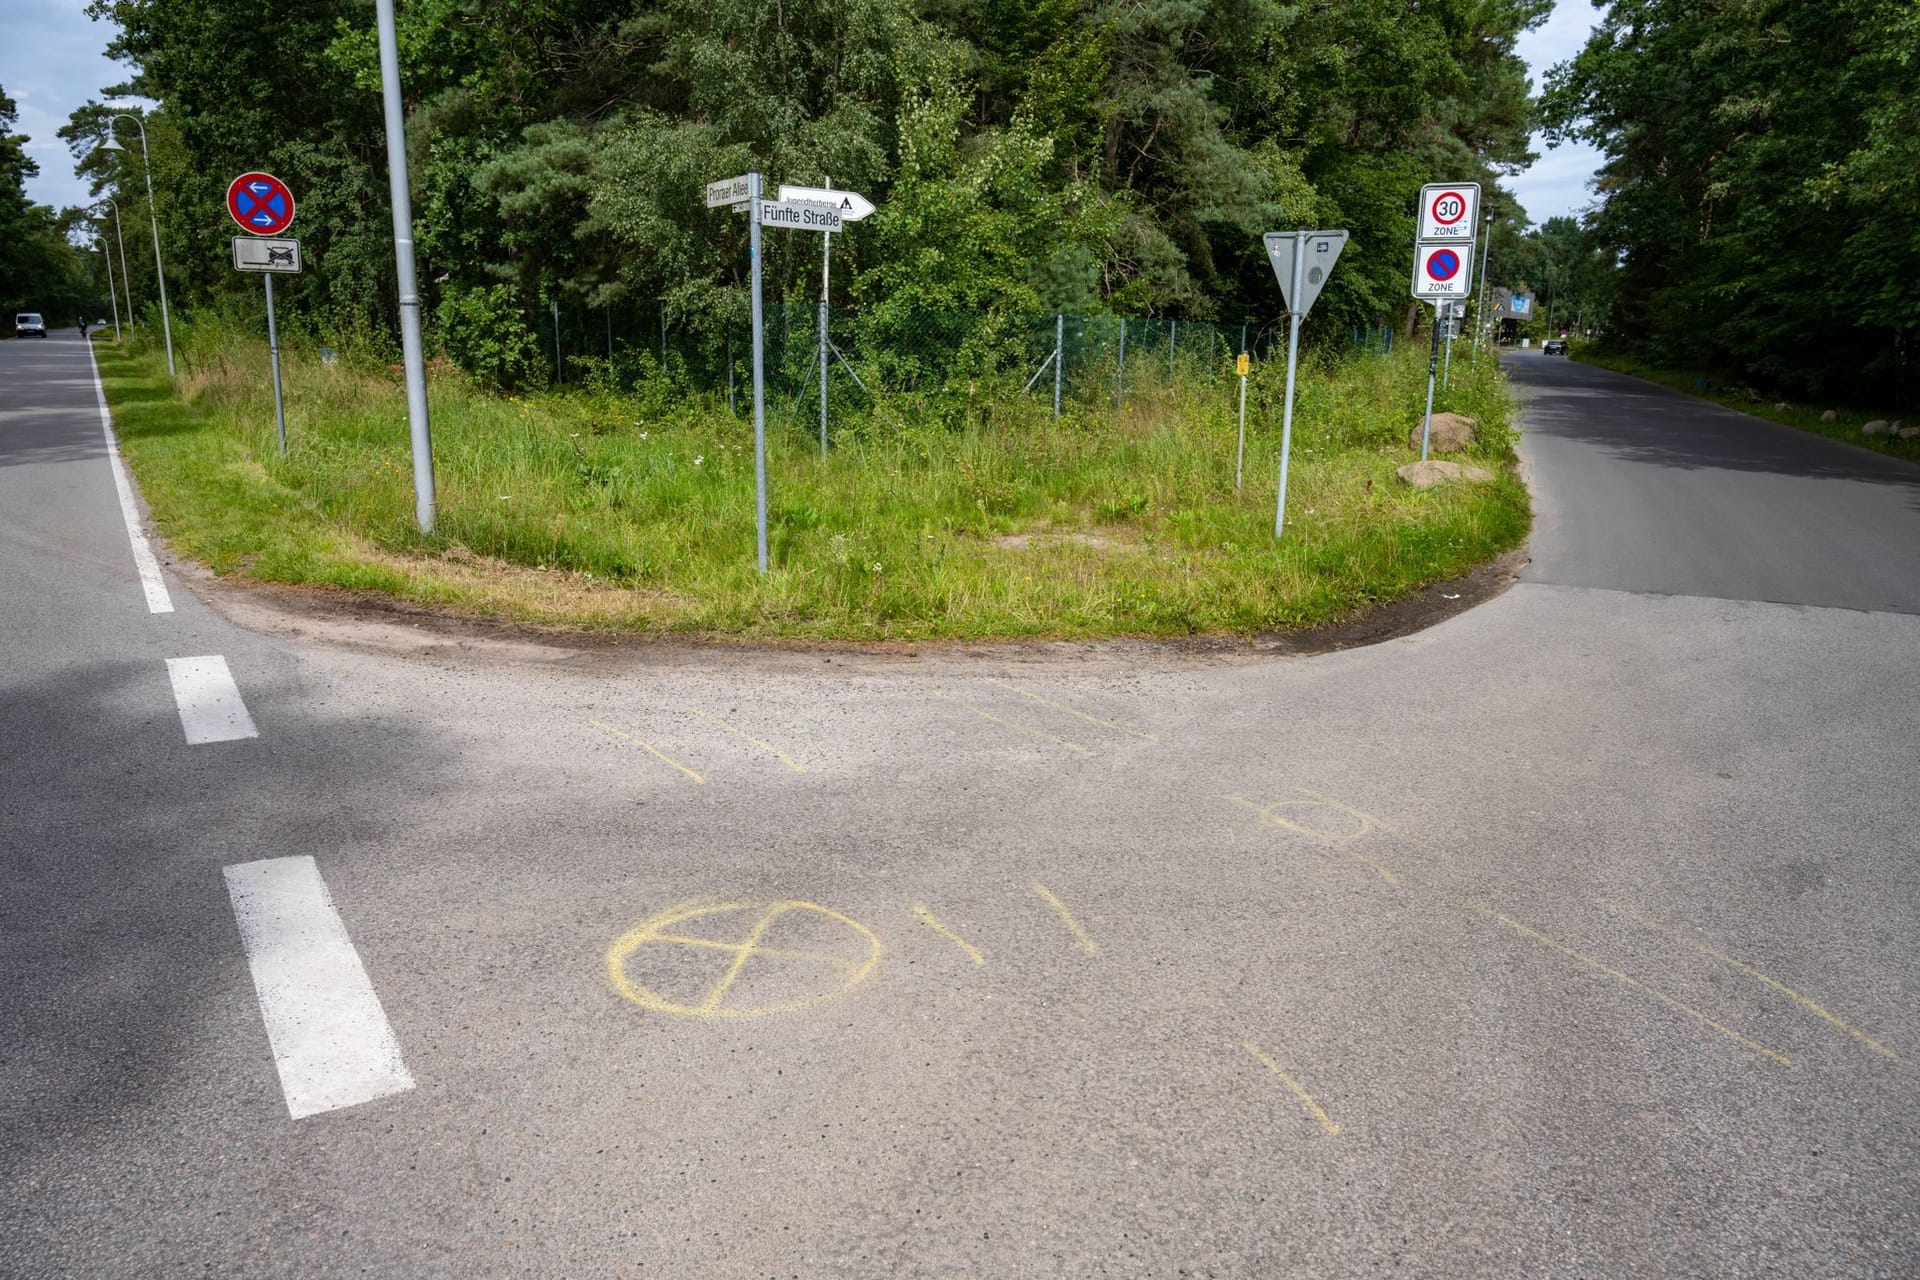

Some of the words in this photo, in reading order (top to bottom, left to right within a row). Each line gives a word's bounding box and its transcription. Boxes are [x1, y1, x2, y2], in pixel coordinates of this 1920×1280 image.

[709, 186, 731, 201] Proraer
[732, 182, 749, 196] Allee
[764, 205, 800, 223] Fünfte
[803, 210, 839, 227] Straße
[1438, 201, 1458, 216] 30
[1433, 226, 1459, 235] ZONE
[1428, 283, 1454, 292] ZONE
